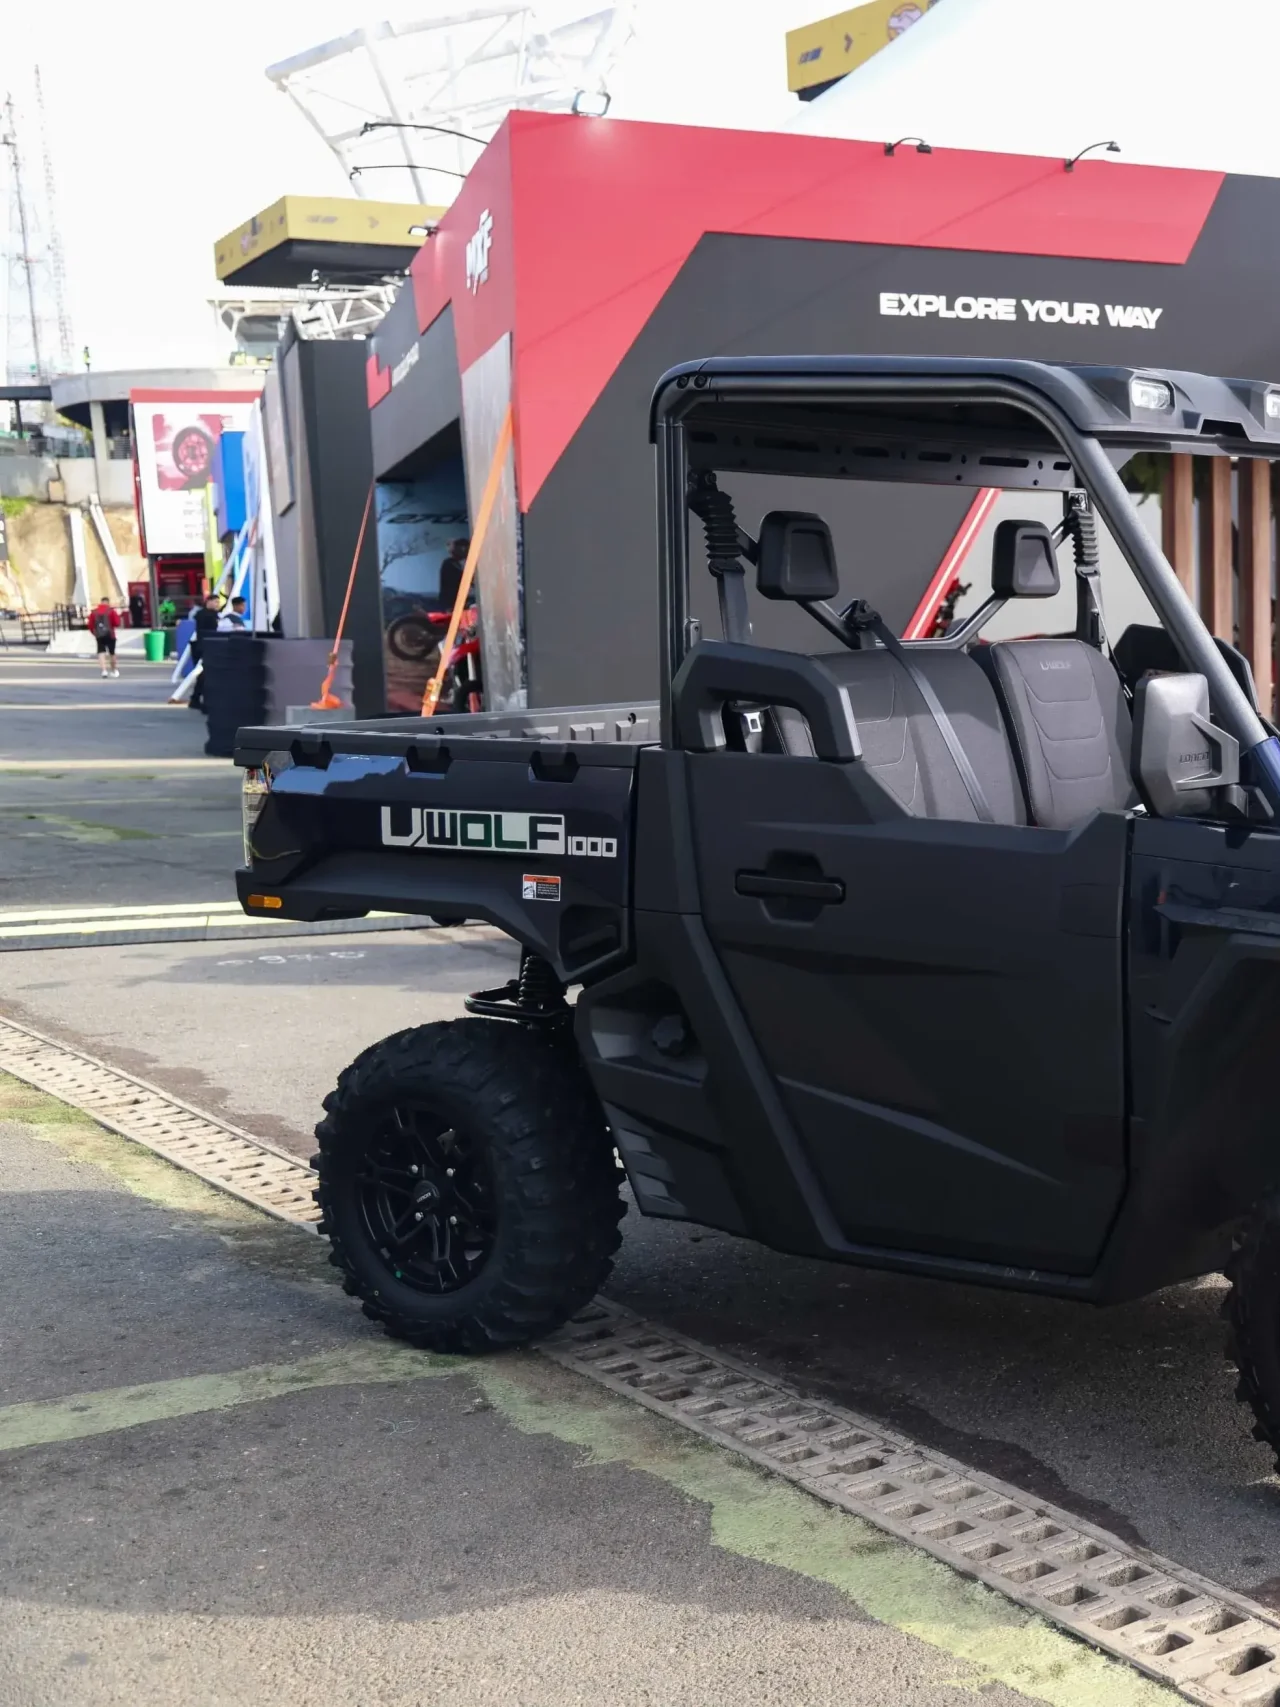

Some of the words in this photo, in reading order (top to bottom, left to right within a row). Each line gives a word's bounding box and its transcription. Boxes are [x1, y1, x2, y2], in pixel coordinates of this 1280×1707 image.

[879, 292, 1017, 321] EXPLORE
[1021, 299, 1100, 325] YOUR
[1104, 304, 1163, 329] WAY
[568, 836, 617, 857] 1000
